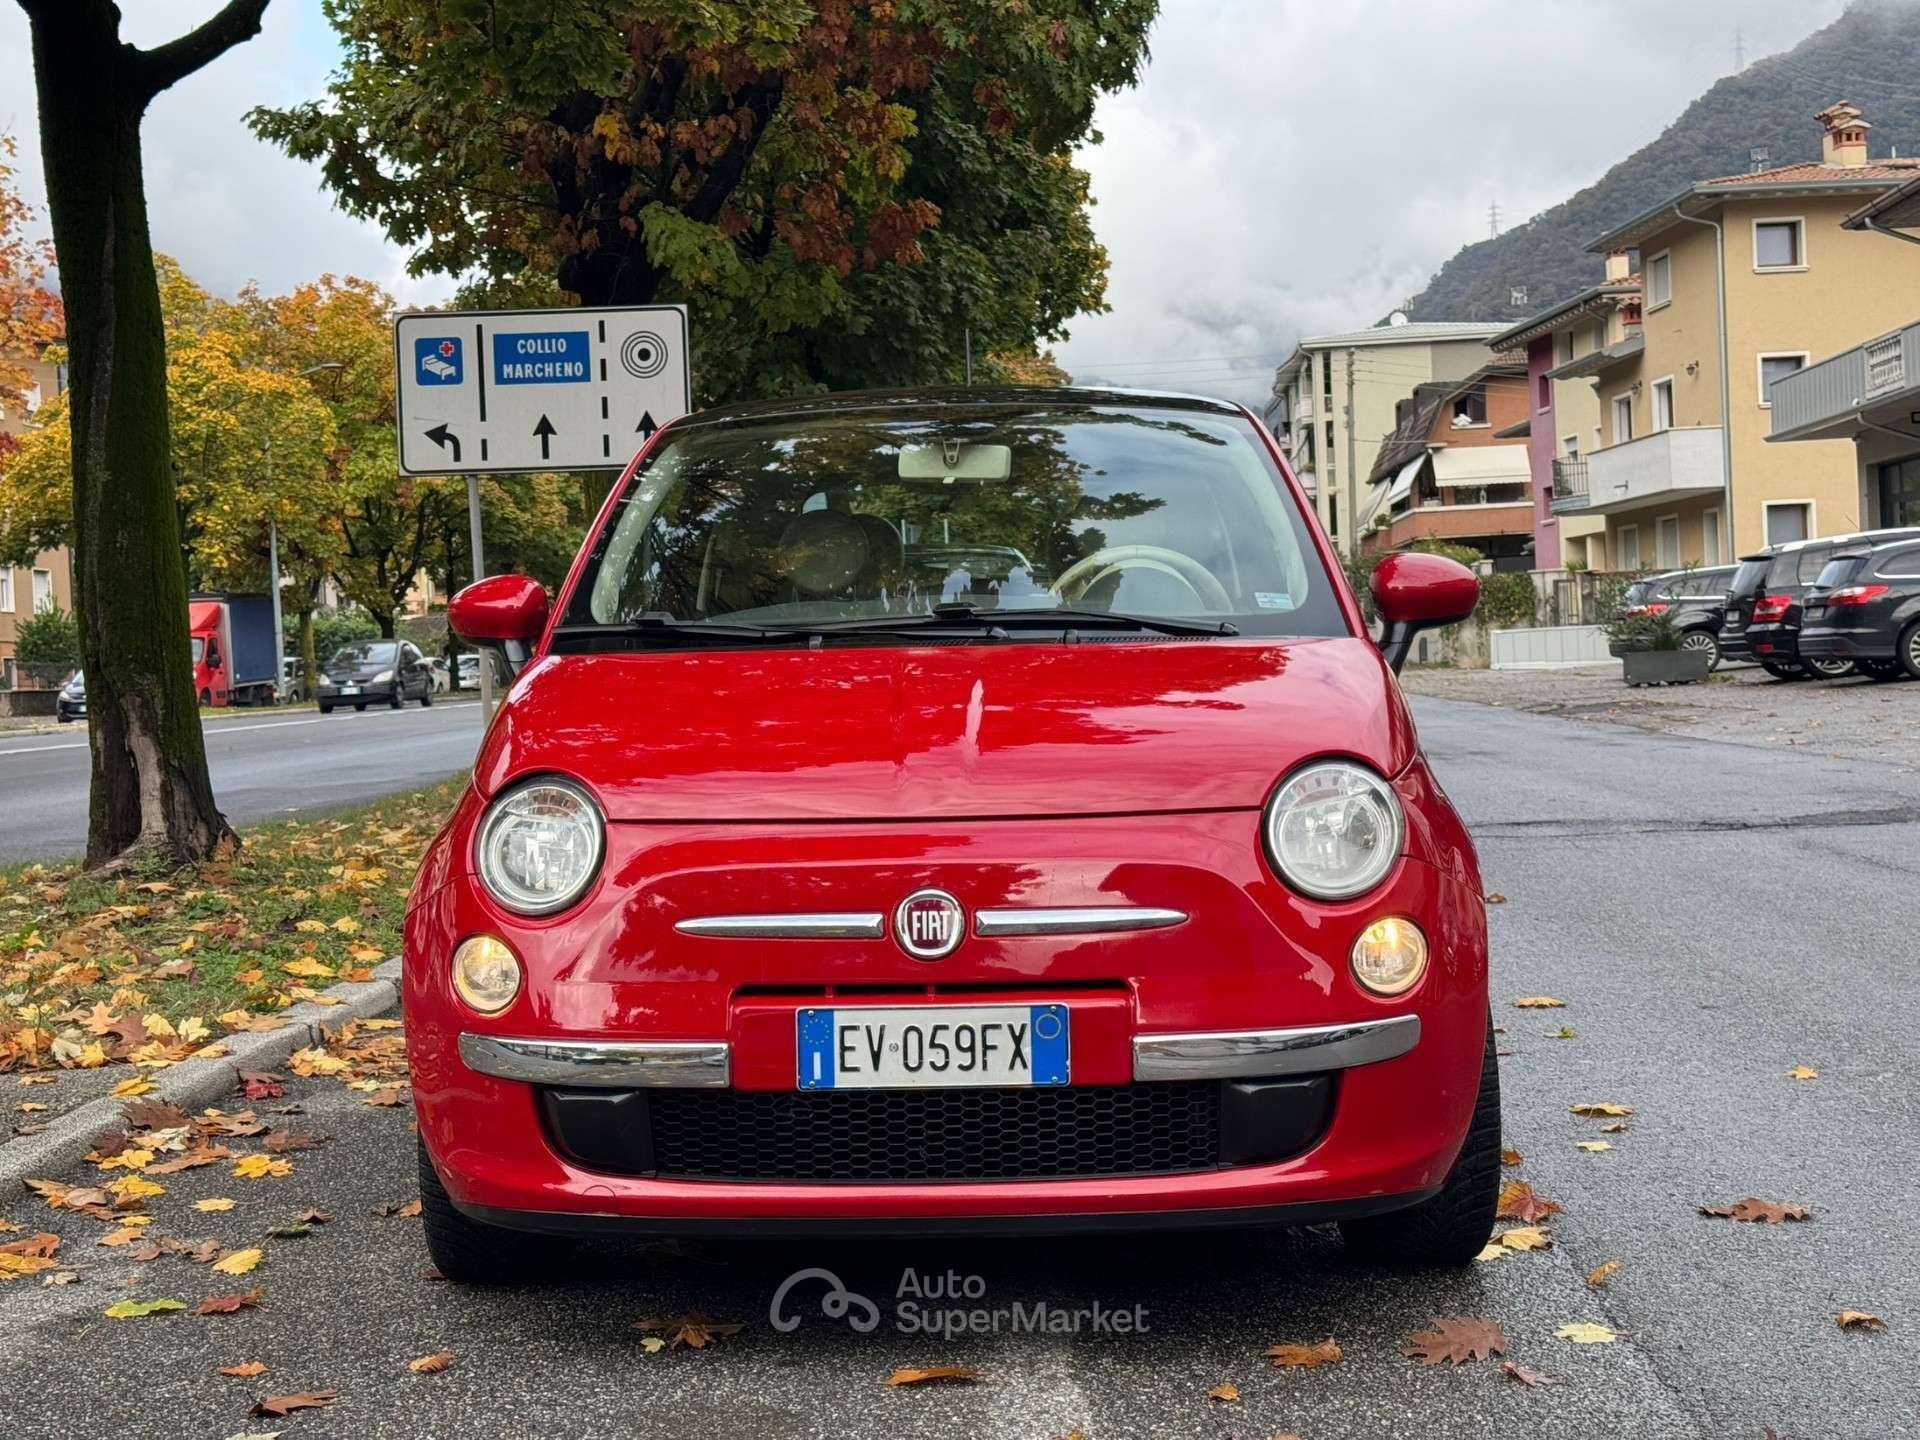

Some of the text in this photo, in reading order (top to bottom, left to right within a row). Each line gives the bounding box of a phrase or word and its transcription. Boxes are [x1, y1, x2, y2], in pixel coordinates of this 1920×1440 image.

[516, 338, 567, 354] COLLIO
[503, 361, 584, 379] MARCHENO
[911, 910, 951, 941] FIAT
